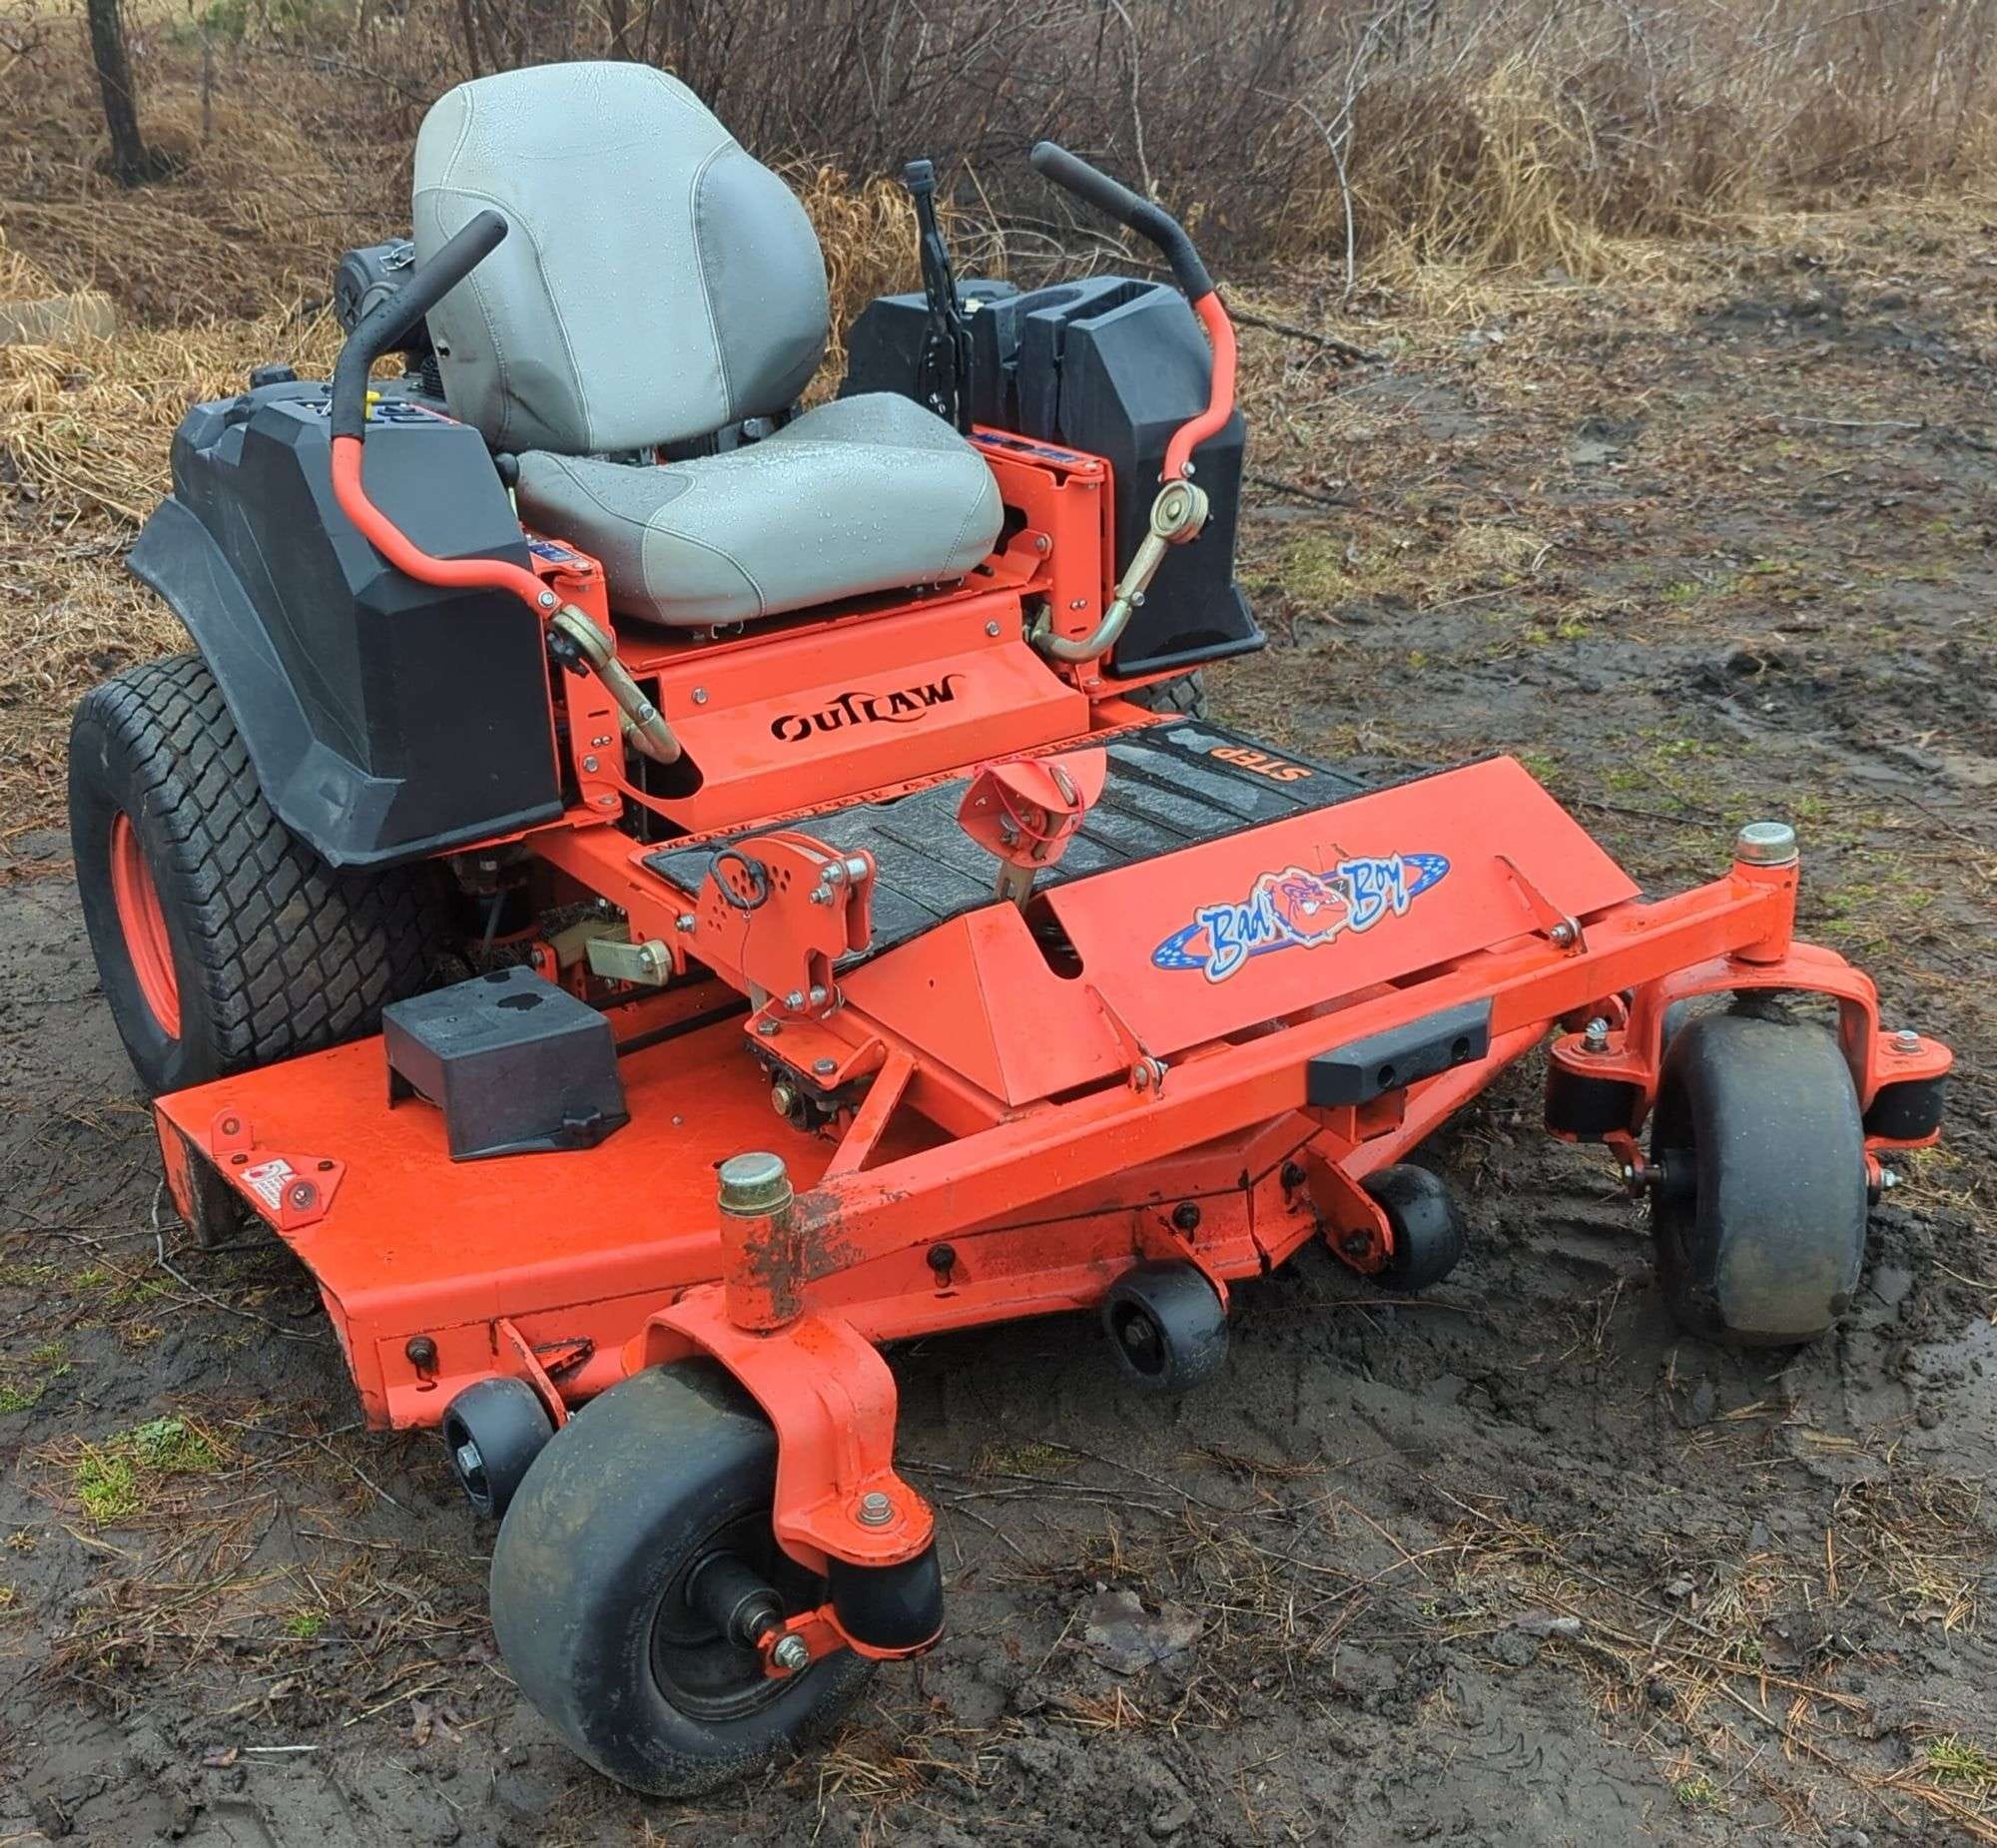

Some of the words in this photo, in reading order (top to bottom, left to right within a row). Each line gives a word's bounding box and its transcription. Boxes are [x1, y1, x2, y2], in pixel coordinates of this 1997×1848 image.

[1210, 746, 1313, 782] STEP
[1199, 893, 1271, 978] Bad
[1340, 858, 1407, 928] Boy
